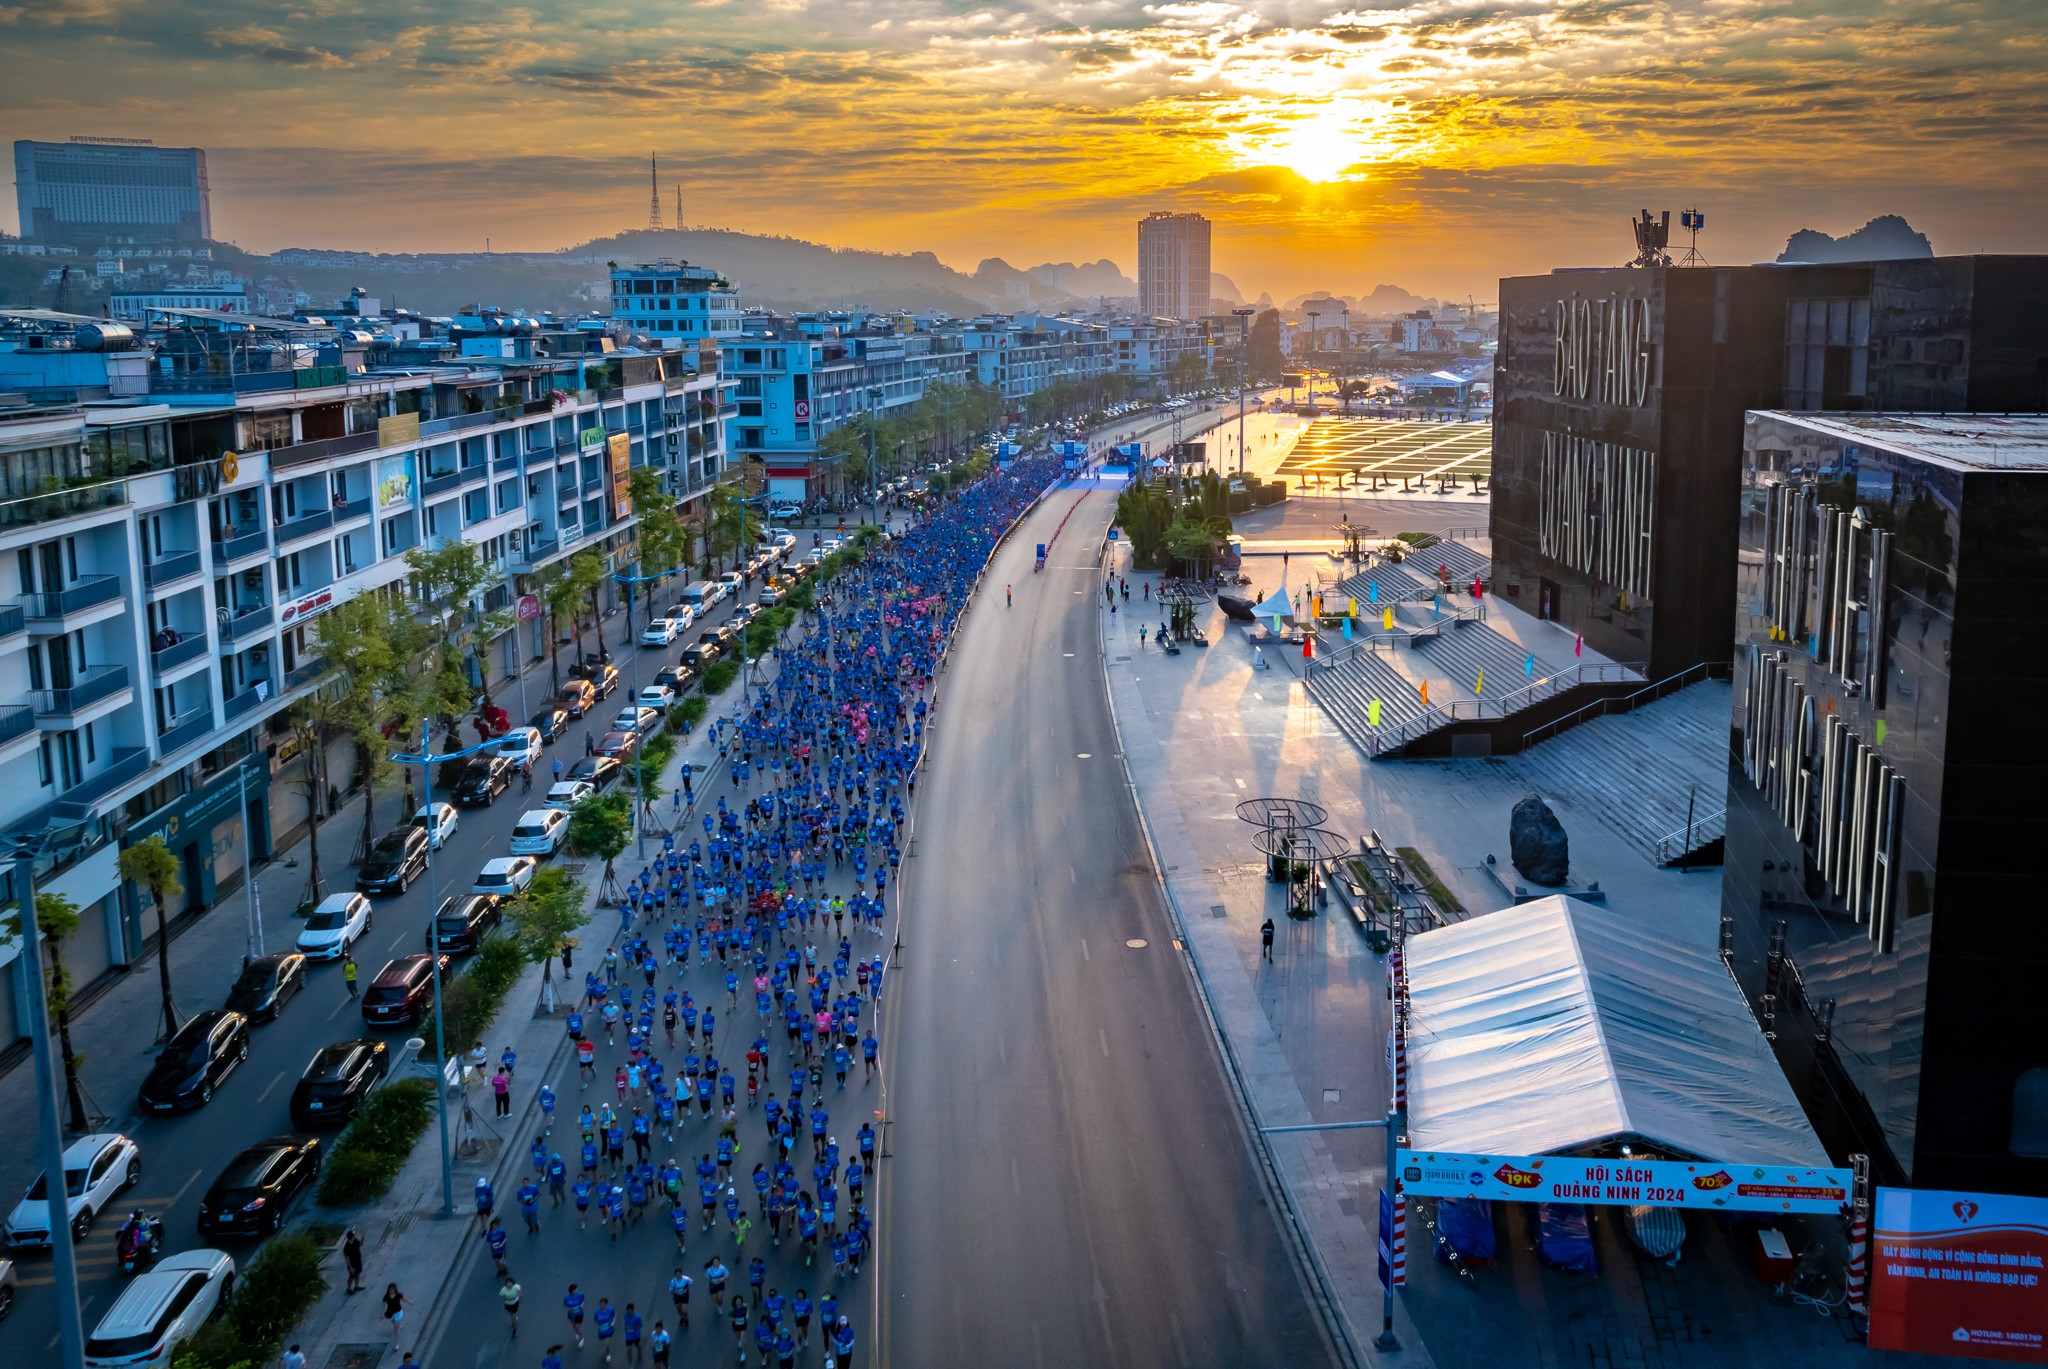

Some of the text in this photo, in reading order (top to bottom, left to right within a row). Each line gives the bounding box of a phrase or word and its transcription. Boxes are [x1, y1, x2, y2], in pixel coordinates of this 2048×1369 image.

[1555, 290, 1651, 408] BẢO TÀNG
[175, 462, 220, 503] BIDV
[1540, 426, 1655, 600] QUẢNG NINH
[1817, 713, 1902, 954] NINH
[1507, 1173, 1532, 1185] 19K
[1586, 1165, 1653, 1184] HỘI SÁCH
[1699, 1177, 1726, 1188] 70%
[1553, 1180, 1685, 1202] QUẢNG NINH 2024
[1900, 1246, 1921, 1260] HÀNH
[1922, 1247, 1943, 1263] ĐỘNG
[1945, 1248, 1953, 1262] VÌ
[1954, 1249, 1976, 1265] CỘNG
[1977, 1249, 1998, 1265] ĐỒNG
[2000, 1251, 2019, 1267] BÌNH
[1928, 1268, 1940, 1279] AN
[1941, 1268, 1962, 1281] TOÀN
[1963, 1268, 1974, 1282] VÀ
[1975, 1270, 2001, 1284] KHÔNG
[2003, 1273, 2019, 1287] BẠO
[1971, 1329, 2004, 1339] HOTLINE:
